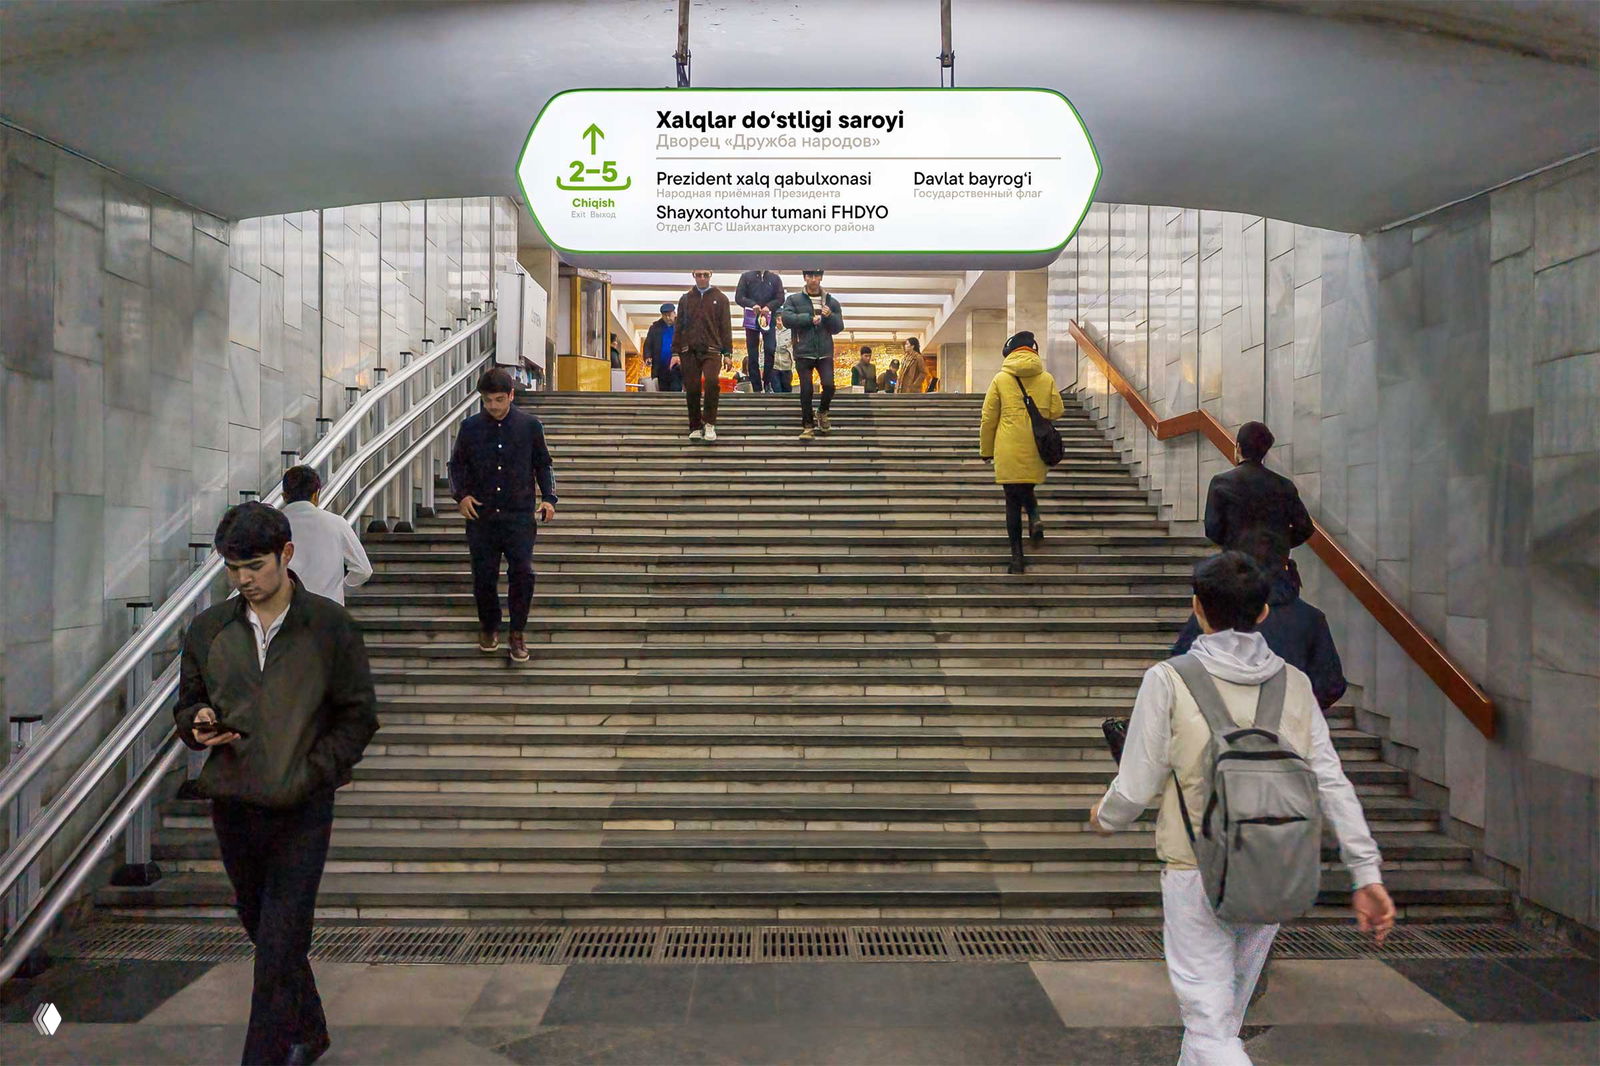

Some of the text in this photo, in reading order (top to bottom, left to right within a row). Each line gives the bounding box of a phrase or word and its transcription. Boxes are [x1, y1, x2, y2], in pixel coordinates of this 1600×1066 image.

[656, 111, 737, 133] Xalqlar
[838, 110, 904, 133] saroyi
[656, 134, 881, 151] Дворец «Дружба народов»
[656, 172, 872, 188] Prezident xalq qabulxonasi
[913, 172, 965, 186] Davlat
[656, 189, 841, 199] Народная приёмная Президента
[913, 189, 1043, 200] Государственный флаг
[572, 198, 615, 209] Chiqish
[571, 211, 586, 219] Exit
[590, 211, 617, 219] Выход
[656, 205, 889, 222] Shayxontohur tumani FHDYO
[656, 221, 875, 233] Отдел ЗАГС Шайхантахурского района
